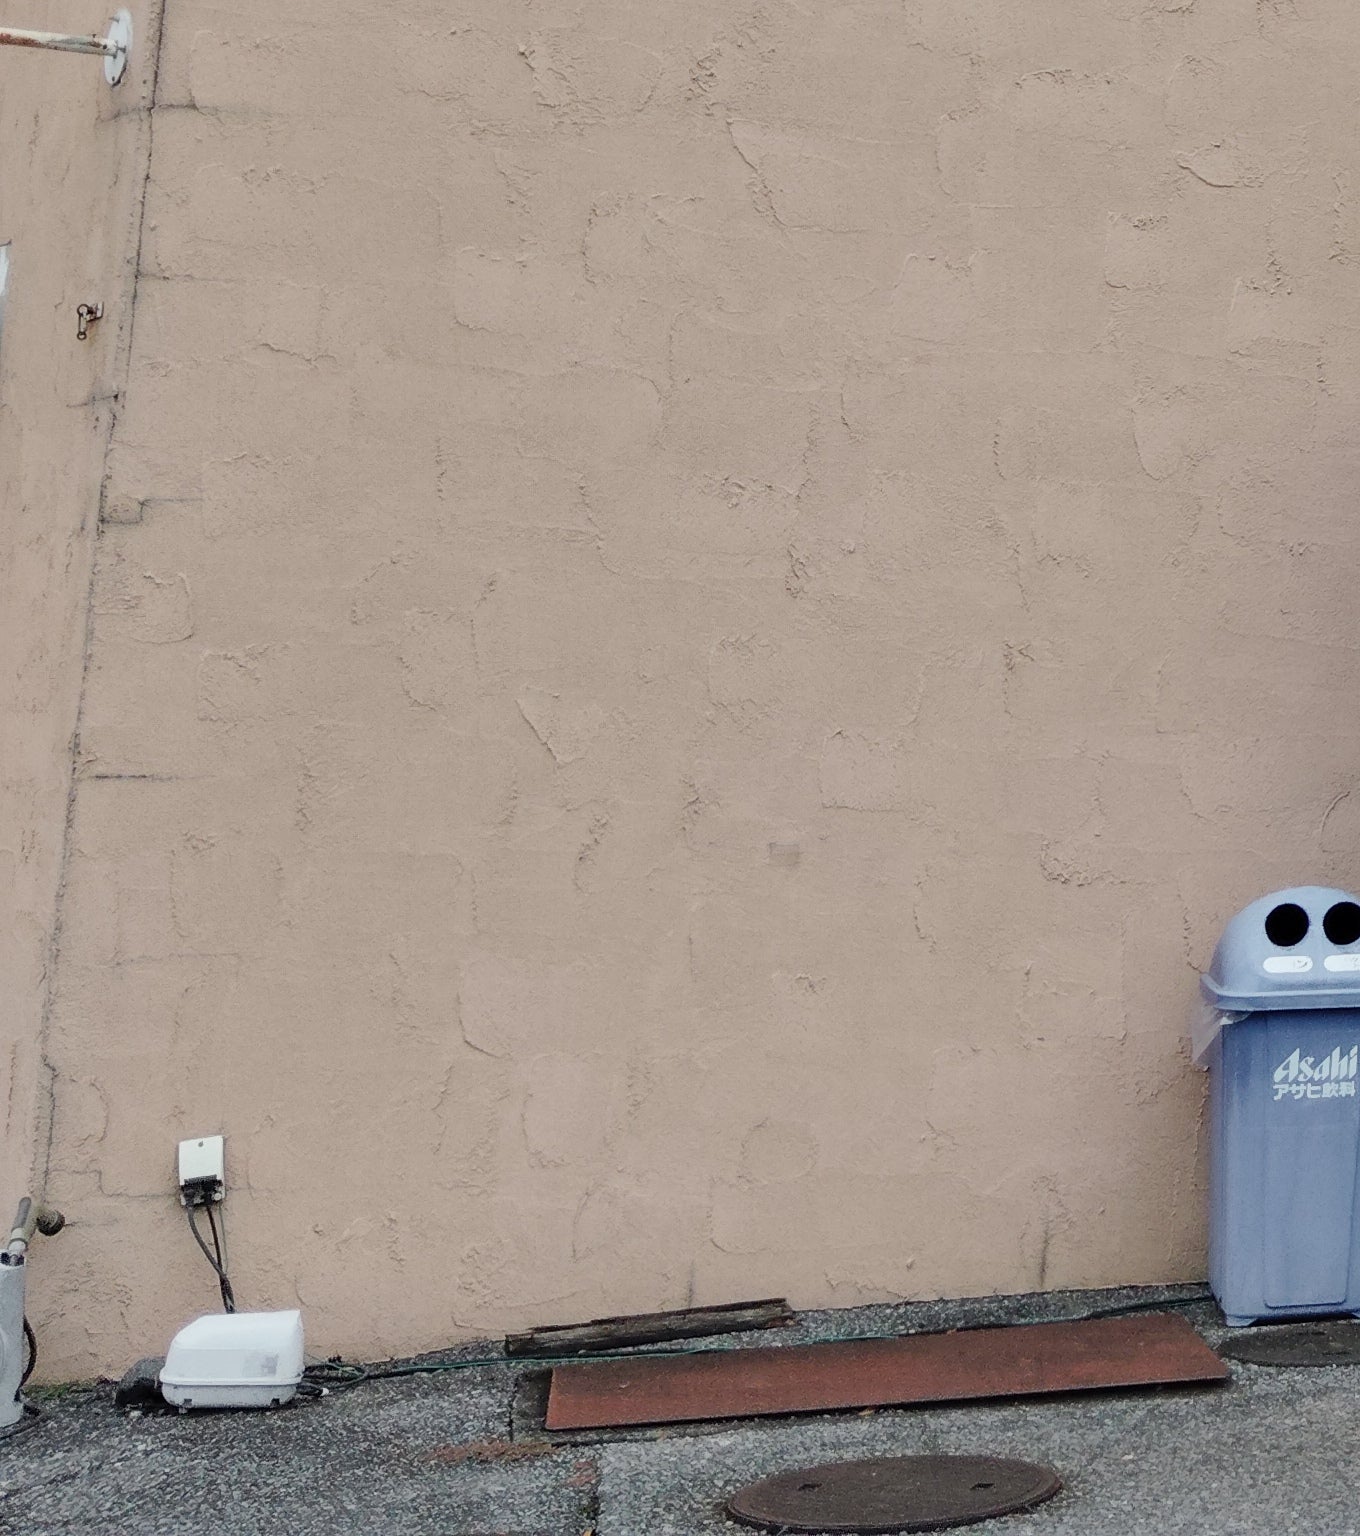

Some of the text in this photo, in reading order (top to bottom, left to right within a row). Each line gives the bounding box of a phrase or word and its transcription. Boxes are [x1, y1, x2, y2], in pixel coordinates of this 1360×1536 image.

[1273, 1044, 1358, 1083] Asahi
[1272, 1080, 1357, 1101] アサヒ飲料
